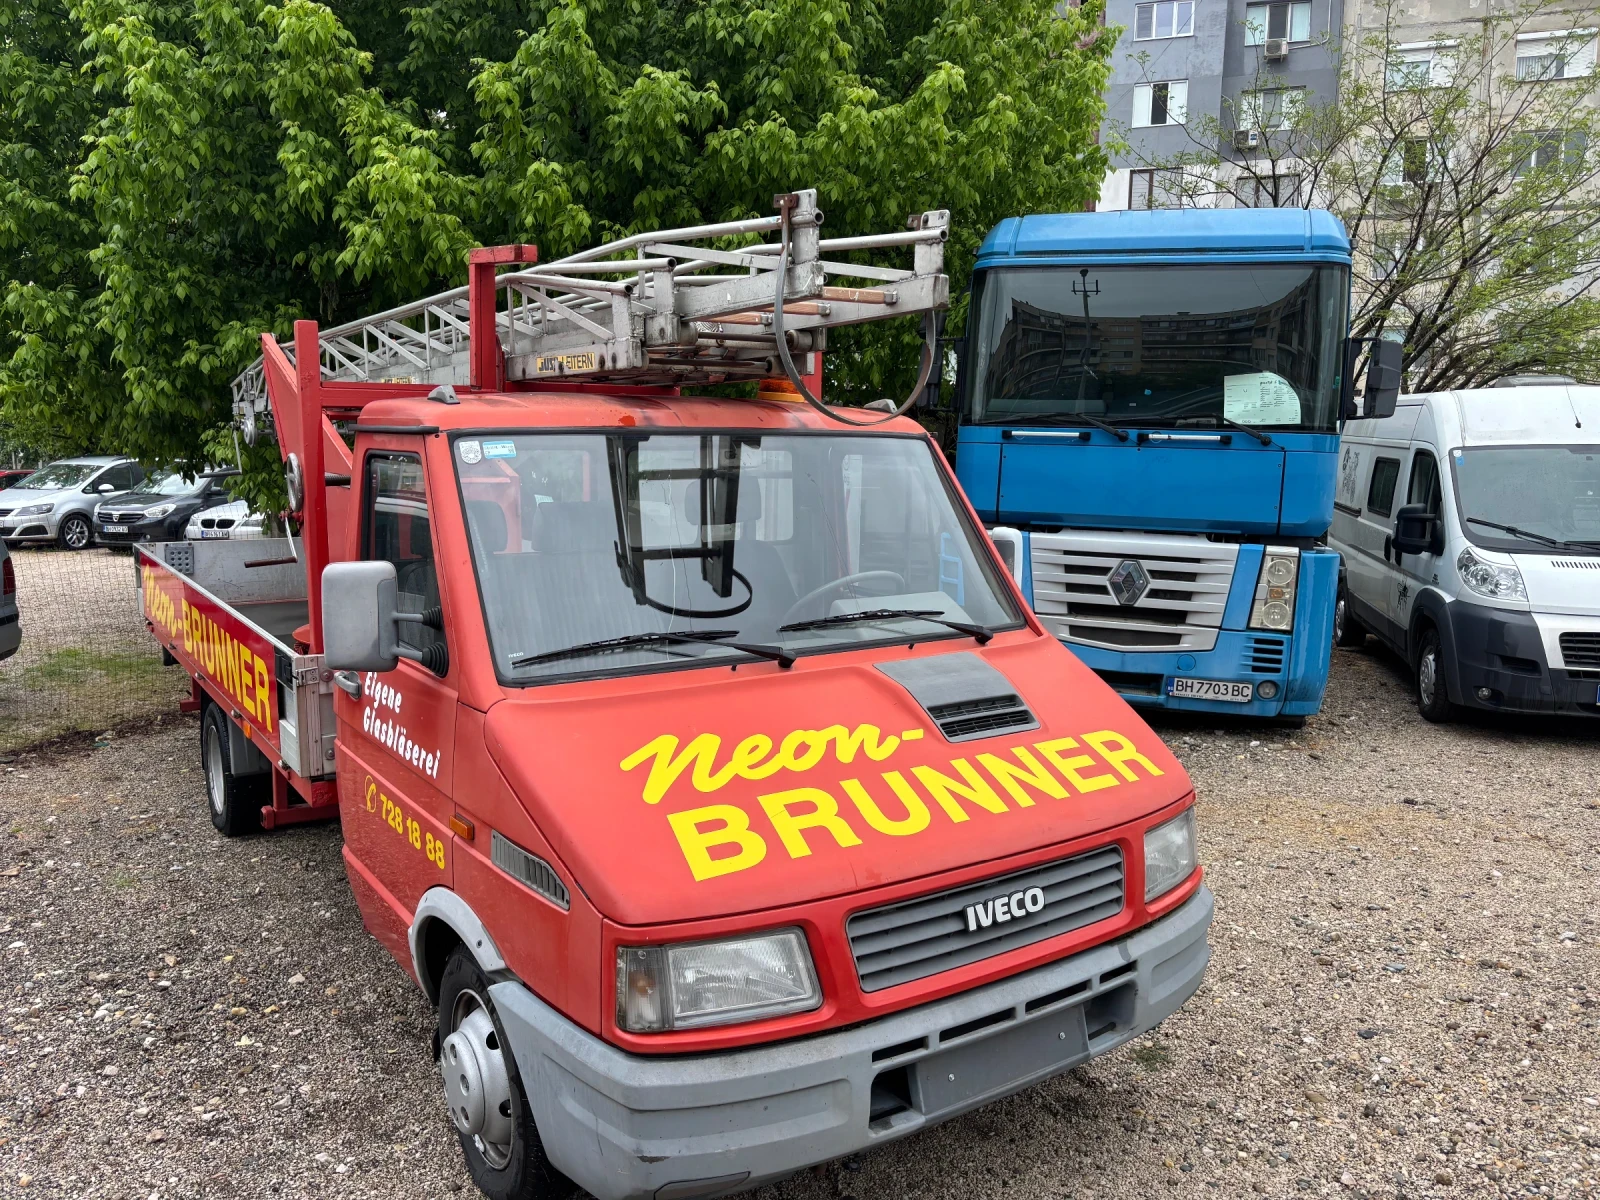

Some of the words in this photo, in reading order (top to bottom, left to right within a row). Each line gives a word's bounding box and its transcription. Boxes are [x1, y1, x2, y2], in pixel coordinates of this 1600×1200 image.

[364, 672, 402, 713] Eigene
[1175, 679, 1194, 693] BH
[1196, 681, 1229, 696] 7703
[1231, 684, 1250, 698] BC
[363, 706, 440, 779] Glasbläserei
[380, 792, 403, 834] 728
[407, 817, 421, 850] 18
[426, 832, 445, 870] 88
[667, 730, 1165, 882] BRUNNER
[966, 887, 1045, 932] IVECO
